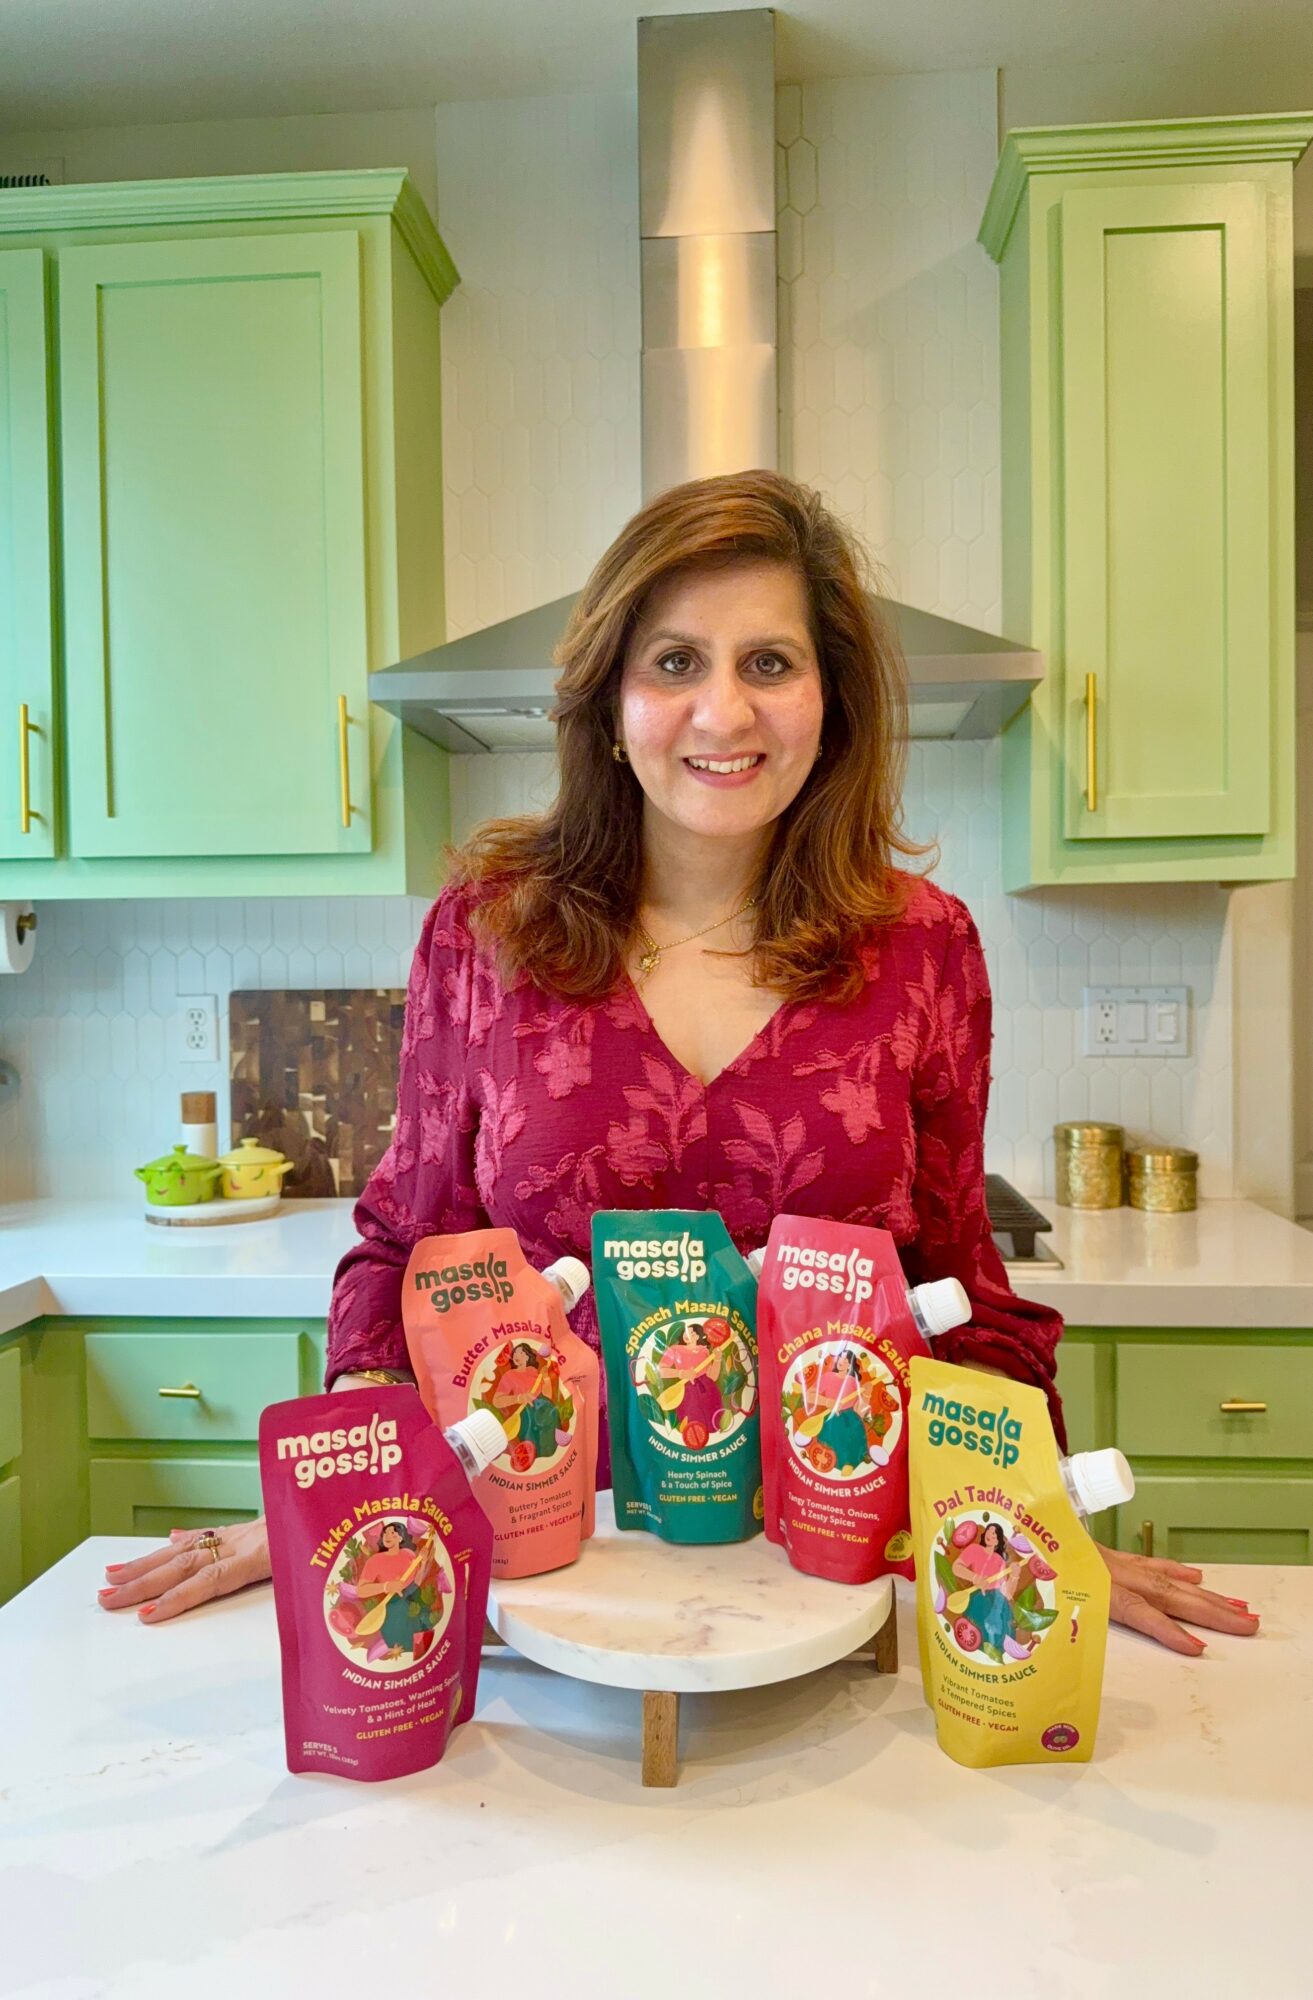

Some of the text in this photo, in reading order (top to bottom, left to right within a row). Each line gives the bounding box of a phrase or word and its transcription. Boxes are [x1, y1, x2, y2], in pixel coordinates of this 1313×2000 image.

[604, 1232, 704, 1258] masala
[777, 1244, 874, 1278] masala
[415, 1253, 507, 1291] masala
[616, 1259, 707, 1282] gossip
[782, 1265, 873, 1303] gossip
[431, 1280, 514, 1313] gossip
[626, 1299, 759, 1357] Spinach Masala Sauce
[777, 1327, 823, 1364] Chana
[827, 1319, 877, 1344] Masala
[452, 1320, 542, 1388] Butter Masala
[921, 1392, 1023, 1441] masala
[277, 1413, 397, 1460] masala
[648, 1433, 748, 1463] INDIAN SIMMER SAUCE
[928, 1419, 1019, 1469] gossip
[295, 1442, 402, 1489] gossip
[488, 1449, 578, 1491] INDIAN SIMMER SAUCE
[667, 1470, 727, 1480] Hearty Spinach
[788, 1457, 887, 1498] INDIAN SIMMER SAUCE
[659, 1493, 737, 1502] GLUTEN FREE VEGAN
[675, 1481, 699, 1489] Touch
[711, 1480, 732, 1489] Spice
[509, 1490, 572, 1514] Buttery Tomatoes
[511, 1500, 573, 1524] & Fragrant Spices
[788, 1491, 880, 1522] Tangy Tomatoes, Onions,
[801, 1508, 856, 1528] & Zesty Spices
[310, 1493, 453, 1568] Tikka Masala Sauce
[494, 1529, 525, 1541] GLUTEN
[526, 1524, 544, 1535] FREE
[792, 1519, 869, 1544] GLUTEN FREE VEGAN
[933, 1485, 1060, 1553] Dal Tadka Sauce
[342, 1639, 452, 1690] INDIAN SIMMER SAUCE
[934, 1631, 1038, 1684] INDIAN SIMMER SAUCE
[323, 1704, 356, 1716] Velvety
[359, 1698, 406, 1713] Tomatoes,
[409, 1682, 443, 1702] Warming
[943, 1674, 1015, 1707] Vibrant Tomatoes
[947, 1687, 984, 1712] Tempered
[987, 1705, 1017, 1718] Spices
[356, 1708, 444, 1740] GLUTEN FREE VEGAN
[367, 1715, 374, 1724] &
[384, 1709, 404, 1721] Hint
[407, 1706, 415, 1718] of
[417, 1698, 436, 1711] Heat
[938, 1698, 1019, 1732] GLUTEN FREE VEGAN
[303, 1741, 332, 1751] SERVES
